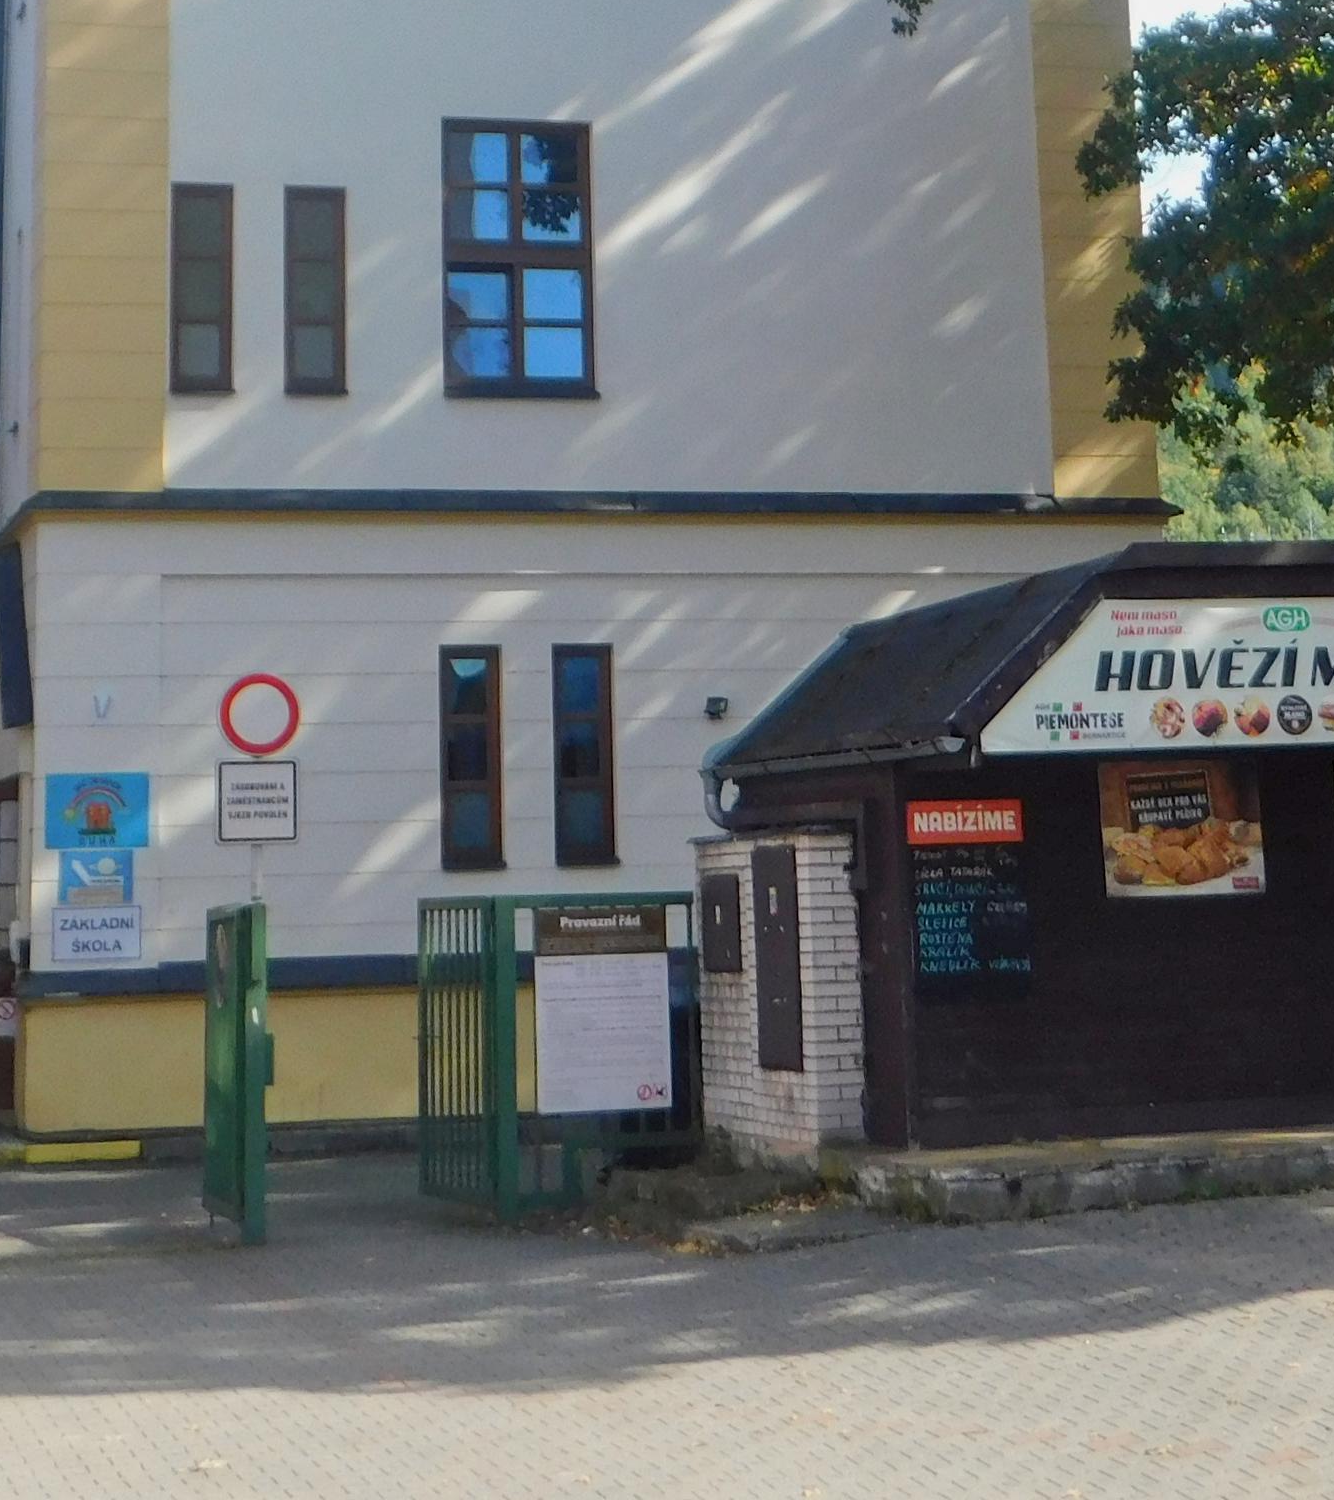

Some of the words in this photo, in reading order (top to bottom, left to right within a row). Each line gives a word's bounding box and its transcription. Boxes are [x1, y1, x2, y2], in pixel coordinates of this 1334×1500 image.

[1266, 607, 1308, 631] AGH
[1095, 638, 1299, 692] HOVĚZÍ
[1035, 712, 1125, 730] PIEMONTESE
[913, 804, 1016, 833] NABÍZÍME
[559, 914, 617, 929] Provozní
[618, 913, 642, 927] řád
[71, 937, 122, 953] ŠKOLA
